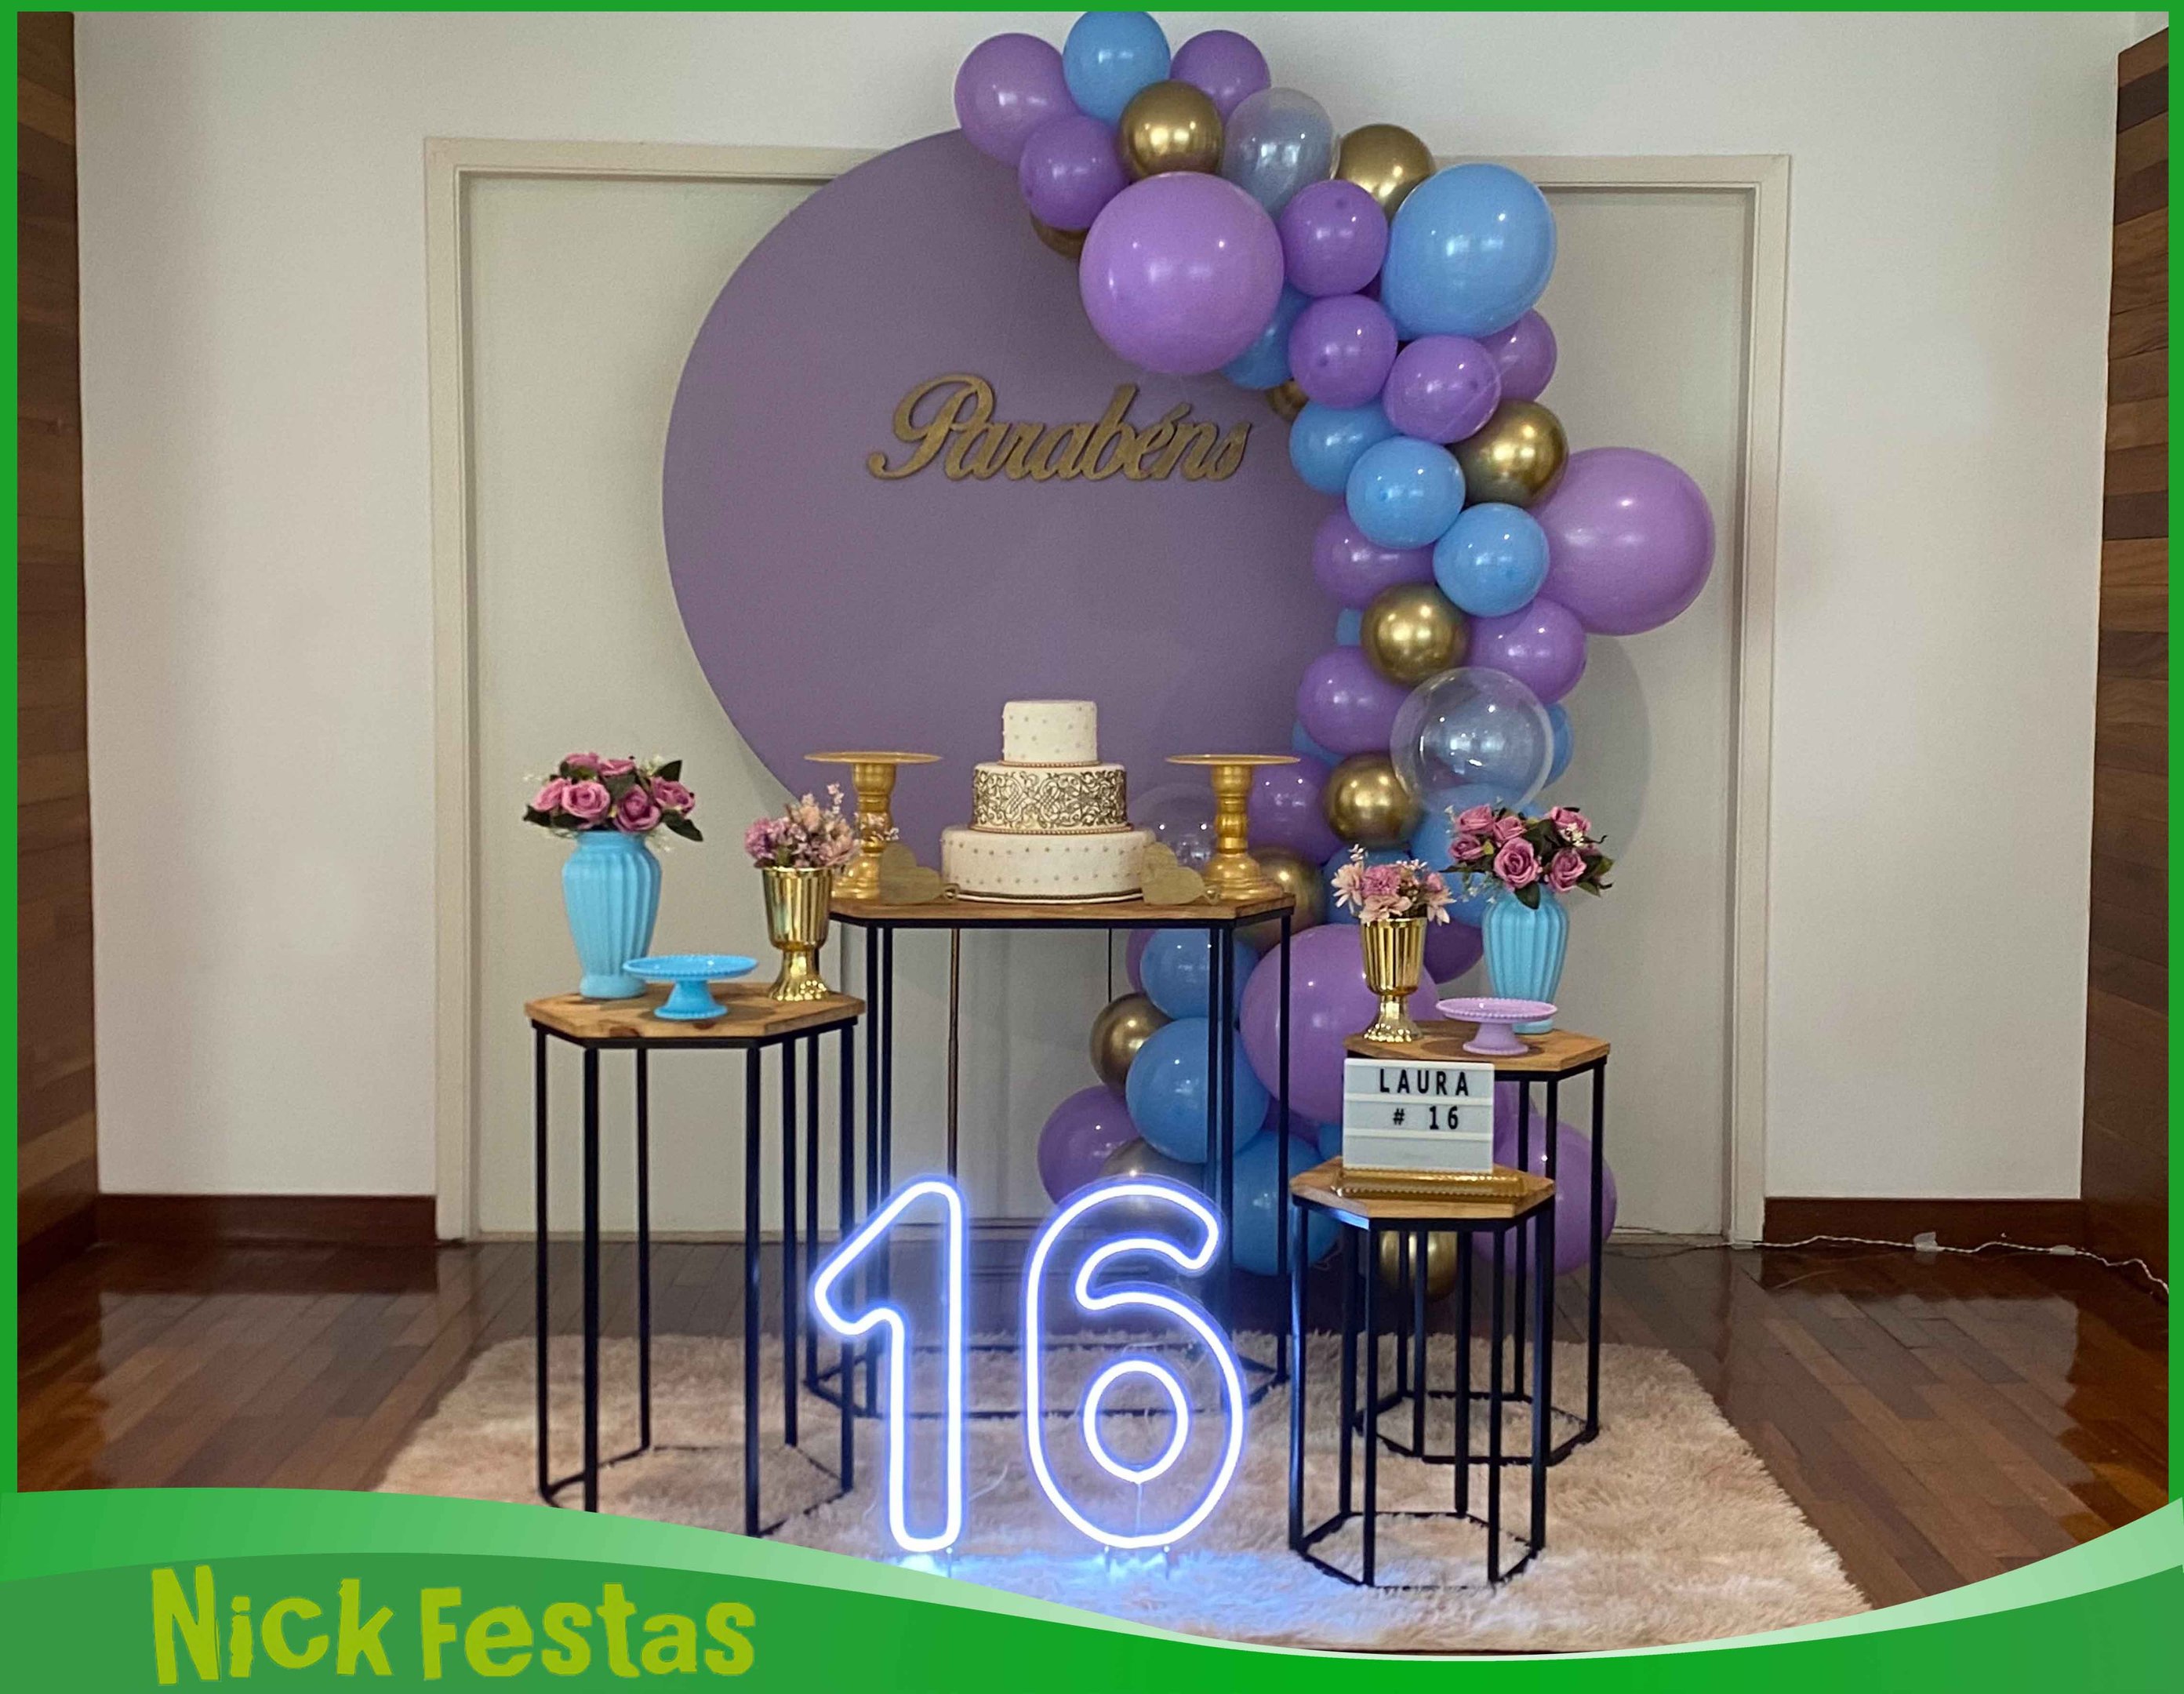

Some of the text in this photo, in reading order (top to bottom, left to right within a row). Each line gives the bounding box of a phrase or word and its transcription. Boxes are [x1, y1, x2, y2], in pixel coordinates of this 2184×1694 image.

[867, 373, 1252, 481] Parabéns
[1379, 1068, 1469, 1096] LAURA
[1392, 1105, 1459, 1130] # 16
[814, 1180, 1244, 1553] 16
